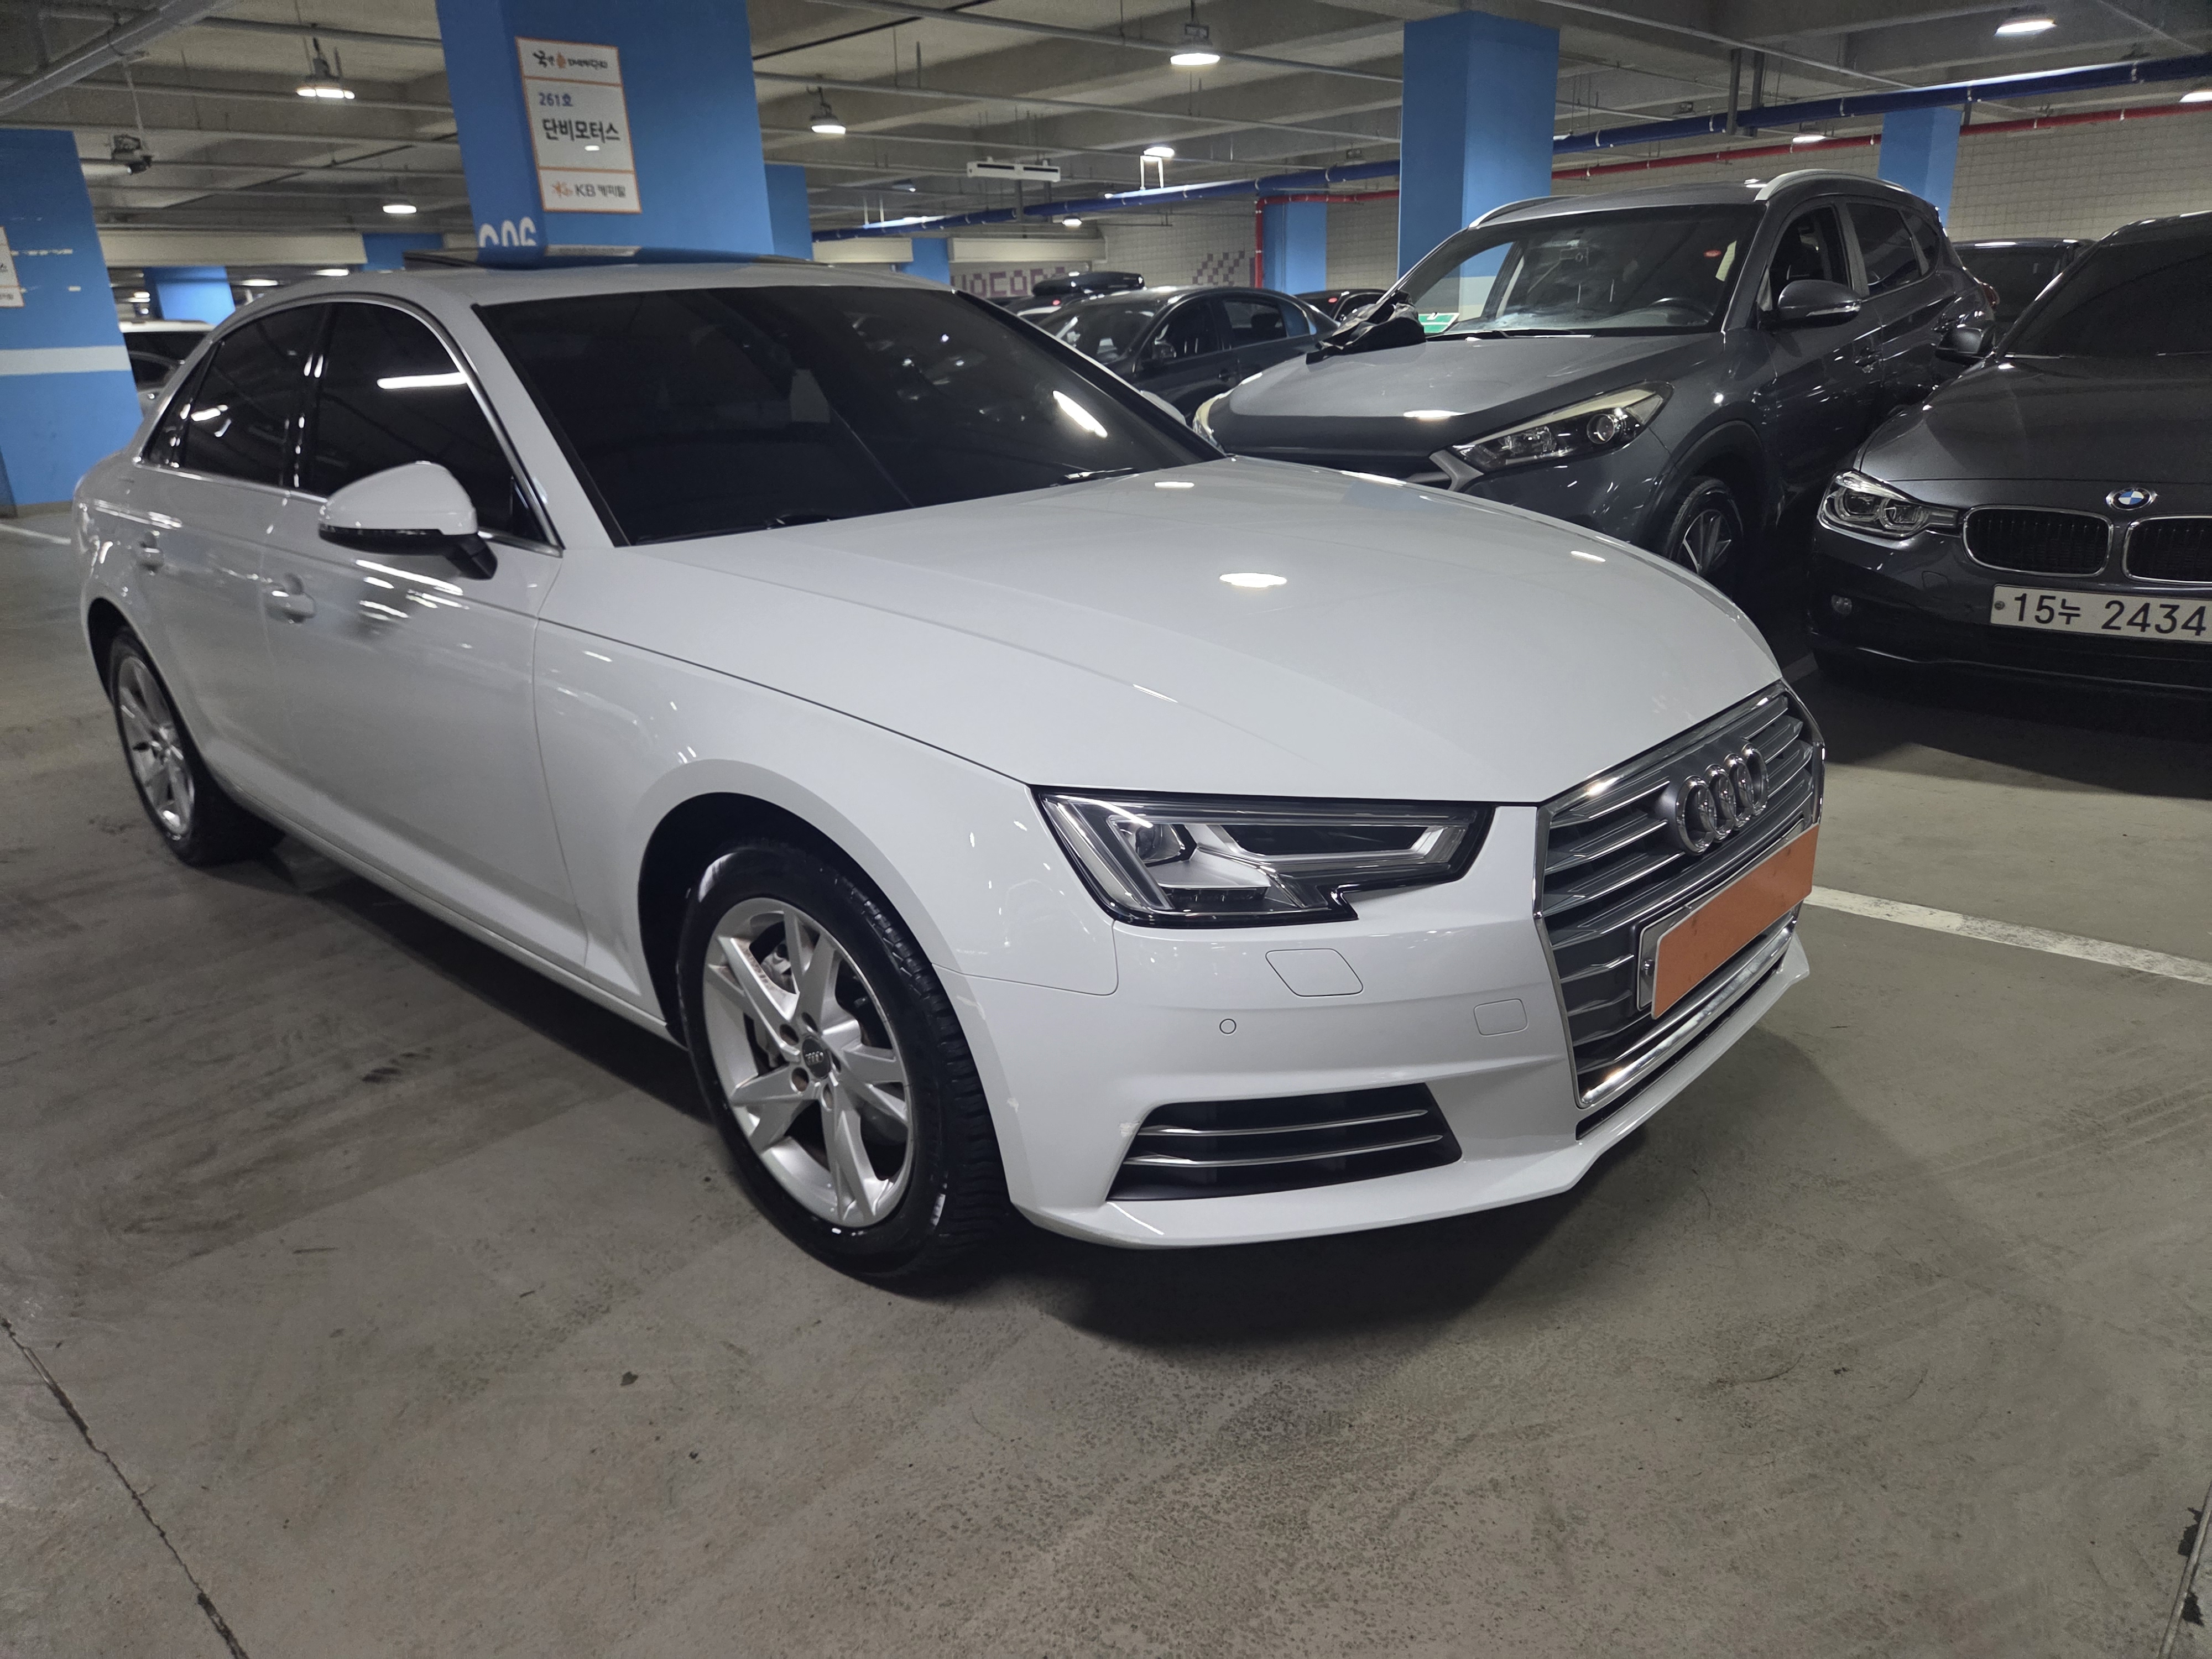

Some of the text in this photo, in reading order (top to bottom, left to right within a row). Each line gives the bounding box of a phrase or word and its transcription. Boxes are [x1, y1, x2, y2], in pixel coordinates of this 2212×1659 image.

[538, 92, 573, 107] 261호
[542, 118, 621, 143] 단비모터스
[574, 183, 596, 197] KB
[2014, 593, 2206, 636] 15누 2434
